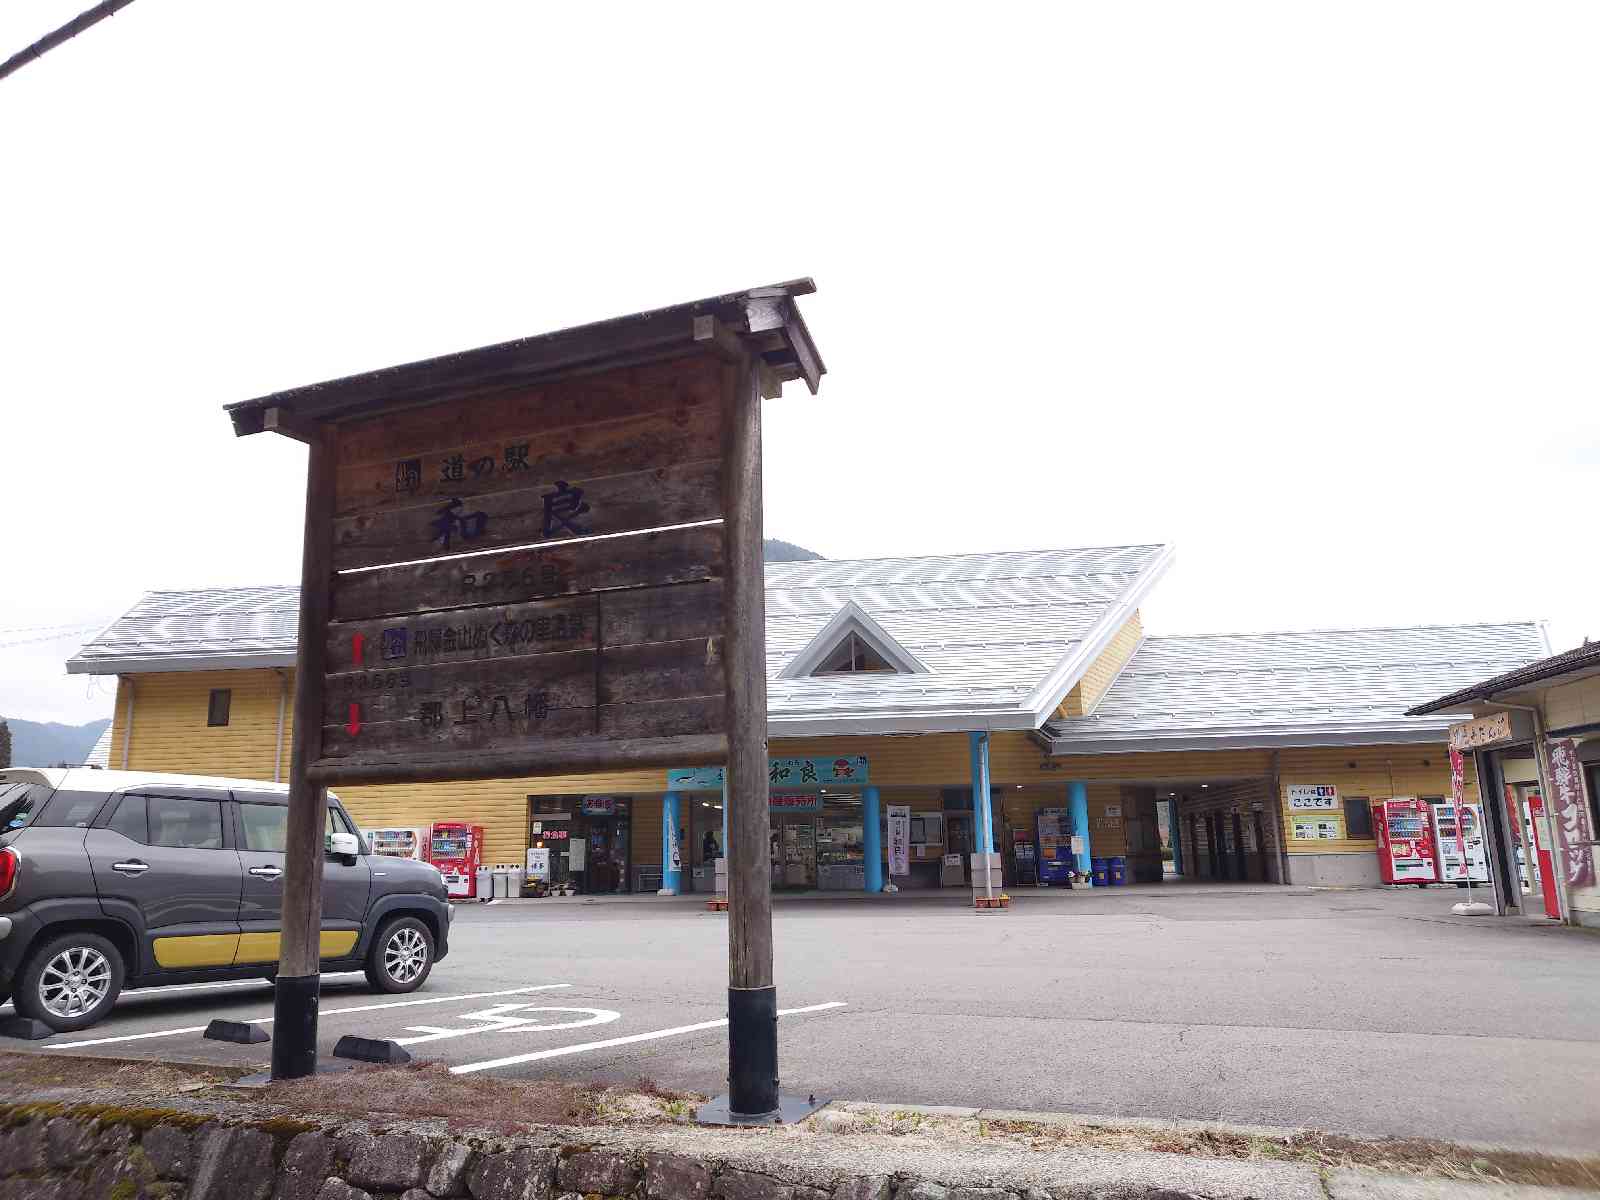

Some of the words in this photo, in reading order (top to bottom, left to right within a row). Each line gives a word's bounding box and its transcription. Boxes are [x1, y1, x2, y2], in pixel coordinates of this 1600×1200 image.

[441, 446, 529, 481] 道の駅
[432, 481, 592, 546] 和良
[769, 760, 818, 784] 和良
[1293, 797, 1333, 808] ここです
